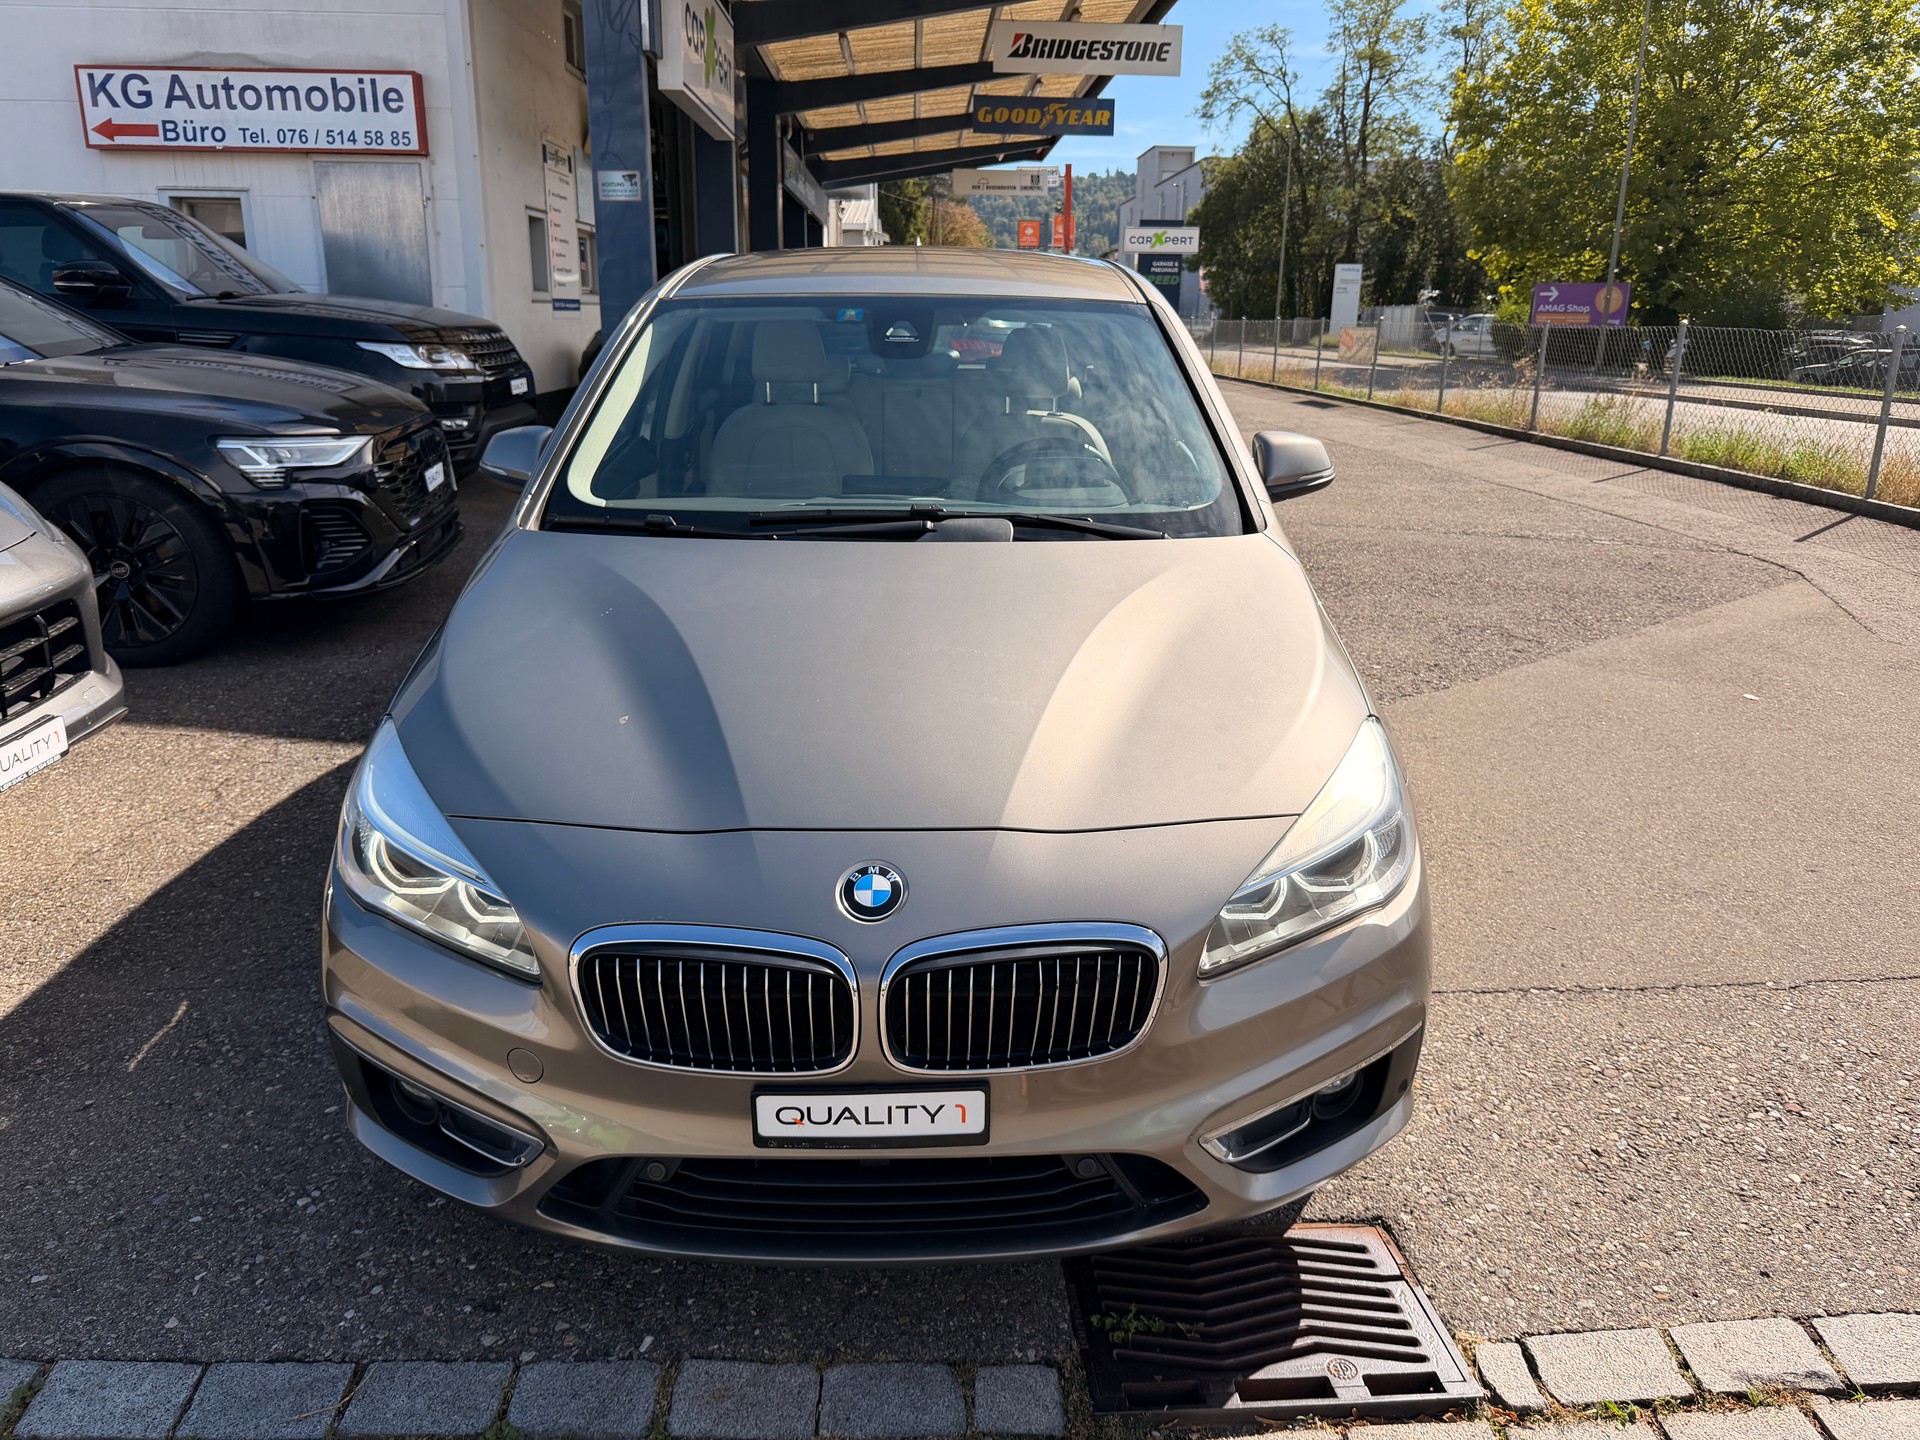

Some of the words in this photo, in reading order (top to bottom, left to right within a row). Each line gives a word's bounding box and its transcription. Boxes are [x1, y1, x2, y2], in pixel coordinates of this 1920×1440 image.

[1008, 33, 1171, 62] BRIDGESTONE
[87, 72, 153, 110] KG
[164, 74, 404, 114] Automobile
[161, 119, 226, 144] Büro
[238, 127, 271, 145] Tel.
[276, 128, 309, 145] 076
[314, 128, 320, 145] /
[326, 129, 358, 146] 514
[363, 129, 384, 146] 58
[391, 130, 412, 147] 85
[1145, 275, 1180, 285] PEED
[1537, 304, 1565, 312] AMAG
[1566, 304, 1590, 313] Shop
[0, 734, 51, 773] UALITY
[850, 865, 899, 883] BMW
[775, 1104, 945, 1126] QUALITY
[955, 1103, 967, 1124] 1
